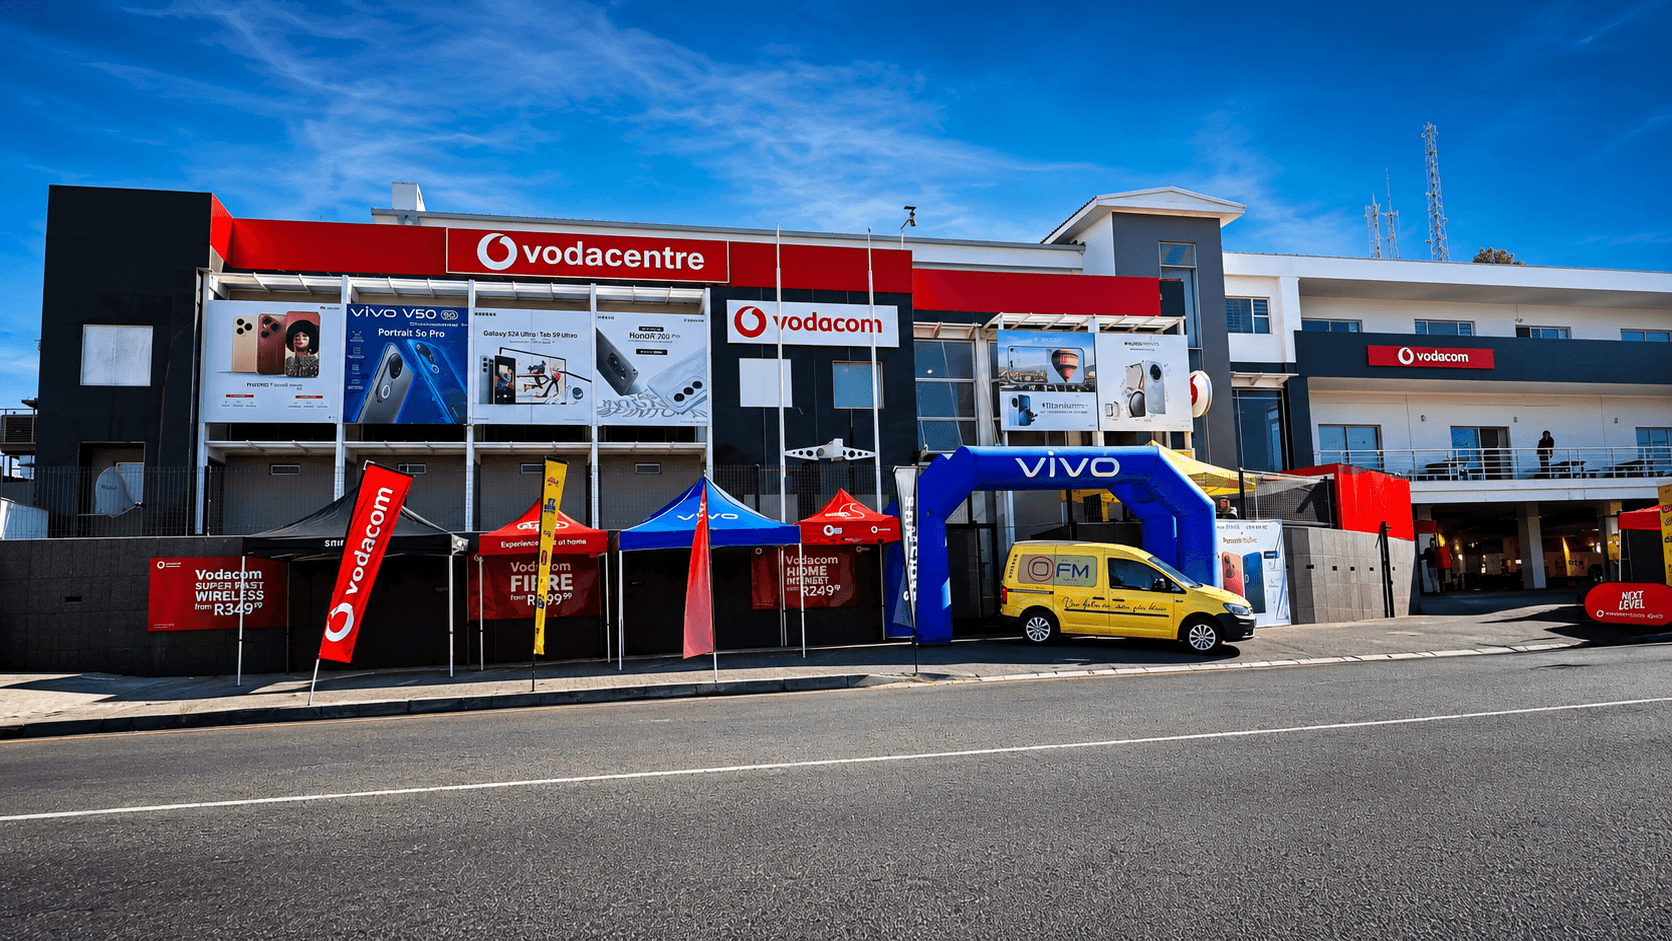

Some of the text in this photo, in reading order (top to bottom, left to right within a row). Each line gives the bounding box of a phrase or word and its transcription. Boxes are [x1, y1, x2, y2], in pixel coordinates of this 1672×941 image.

[522, 241, 705, 271] vodacentre
[350, 306, 397, 318] vivo
[402, 308, 437, 320] V50
[772, 312, 883, 334] vodacom
[378, 328, 445, 338] Portrait So Pro
[1416, 350, 1469, 363] vodacom
[1014, 450, 1120, 478] vivo
[676, 512, 739, 521] vvo
[345, 487, 394, 595] vodacom
[785, 554, 839, 565] Vodacom
[510, 561, 571, 573] Vodom
[195, 568, 262, 581] Vodacom
[195, 582, 232, 590] SUPER
[195, 590, 264, 602] WIRELESS
[527, 593, 562, 606] R99
[1618, 599, 1646, 610] LEVEL
